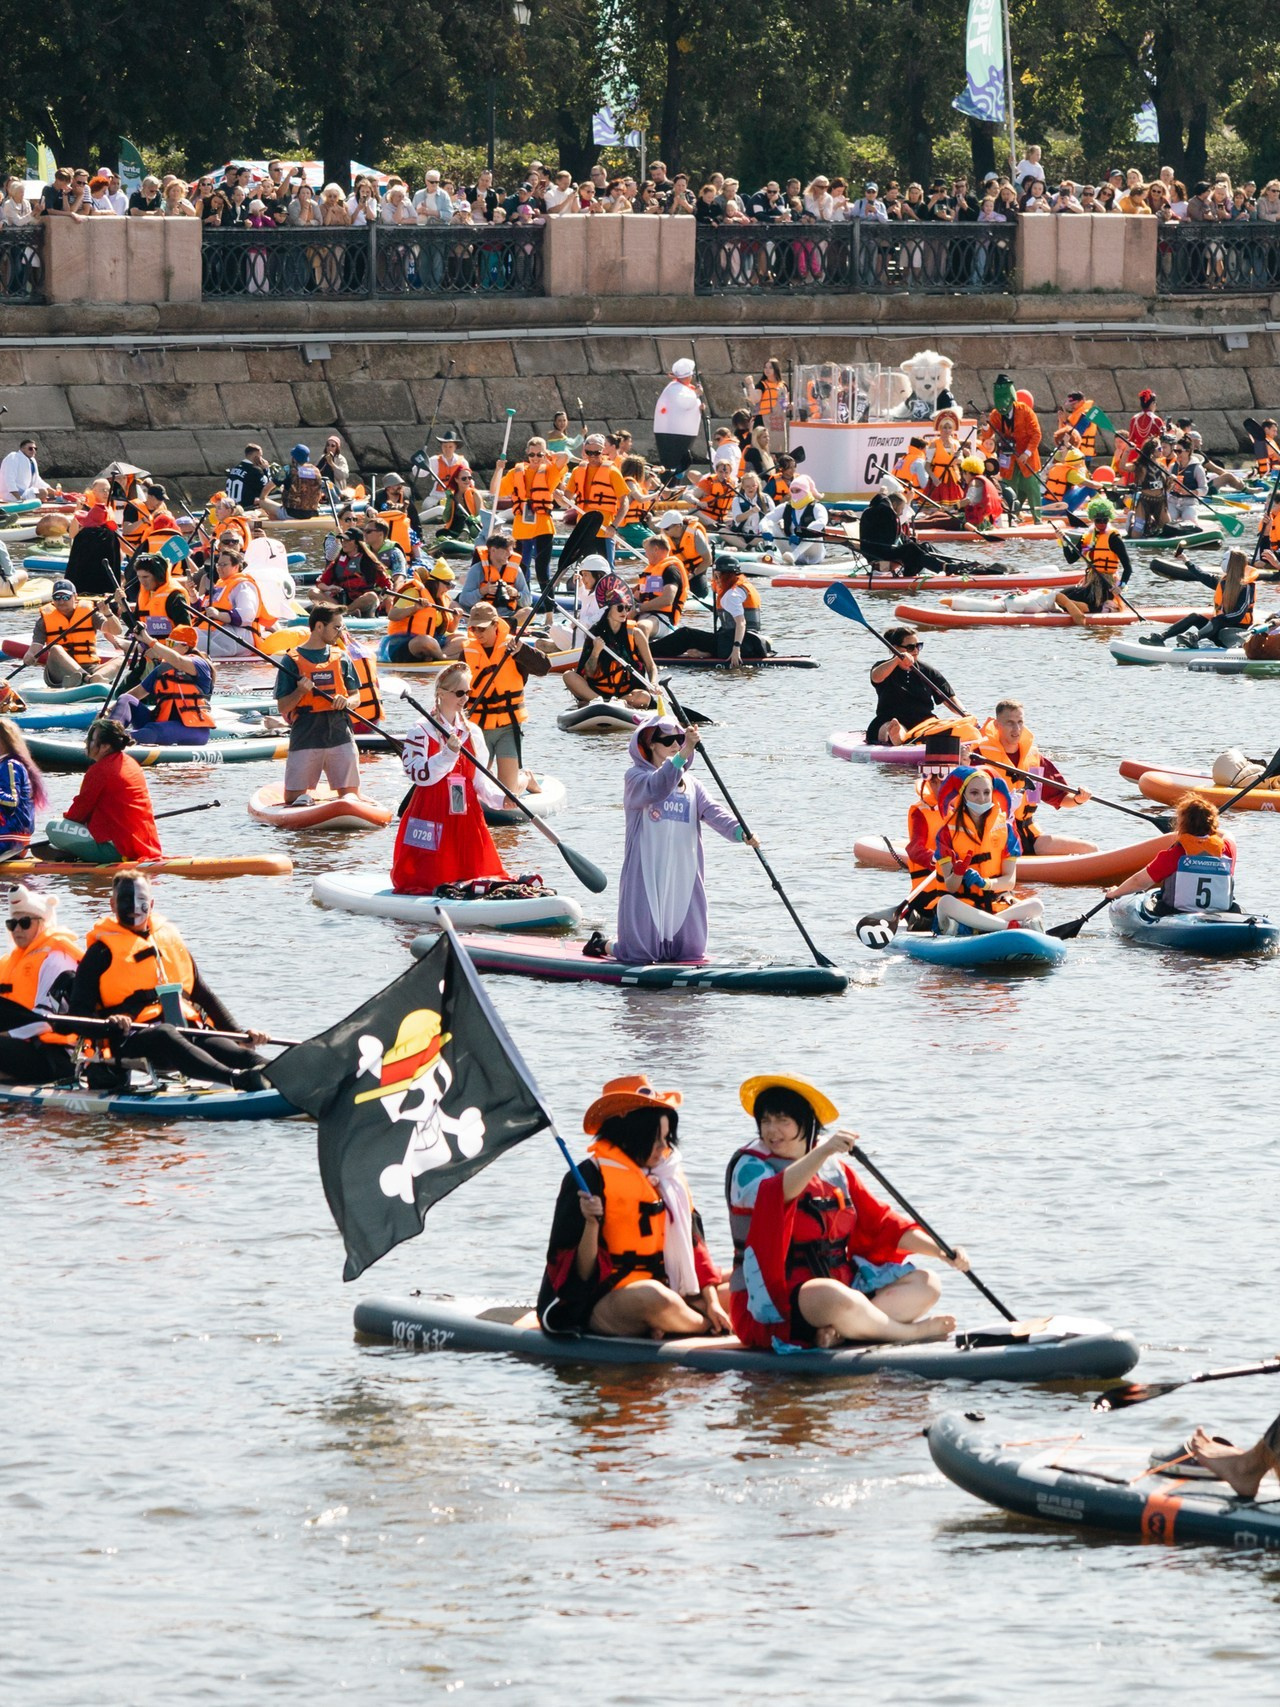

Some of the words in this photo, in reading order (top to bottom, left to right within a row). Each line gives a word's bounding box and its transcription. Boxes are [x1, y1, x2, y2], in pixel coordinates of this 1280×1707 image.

[663, 801, 685, 813] 0943
[412, 828, 433, 842] 0728
[1195, 877, 1212, 909] 5
